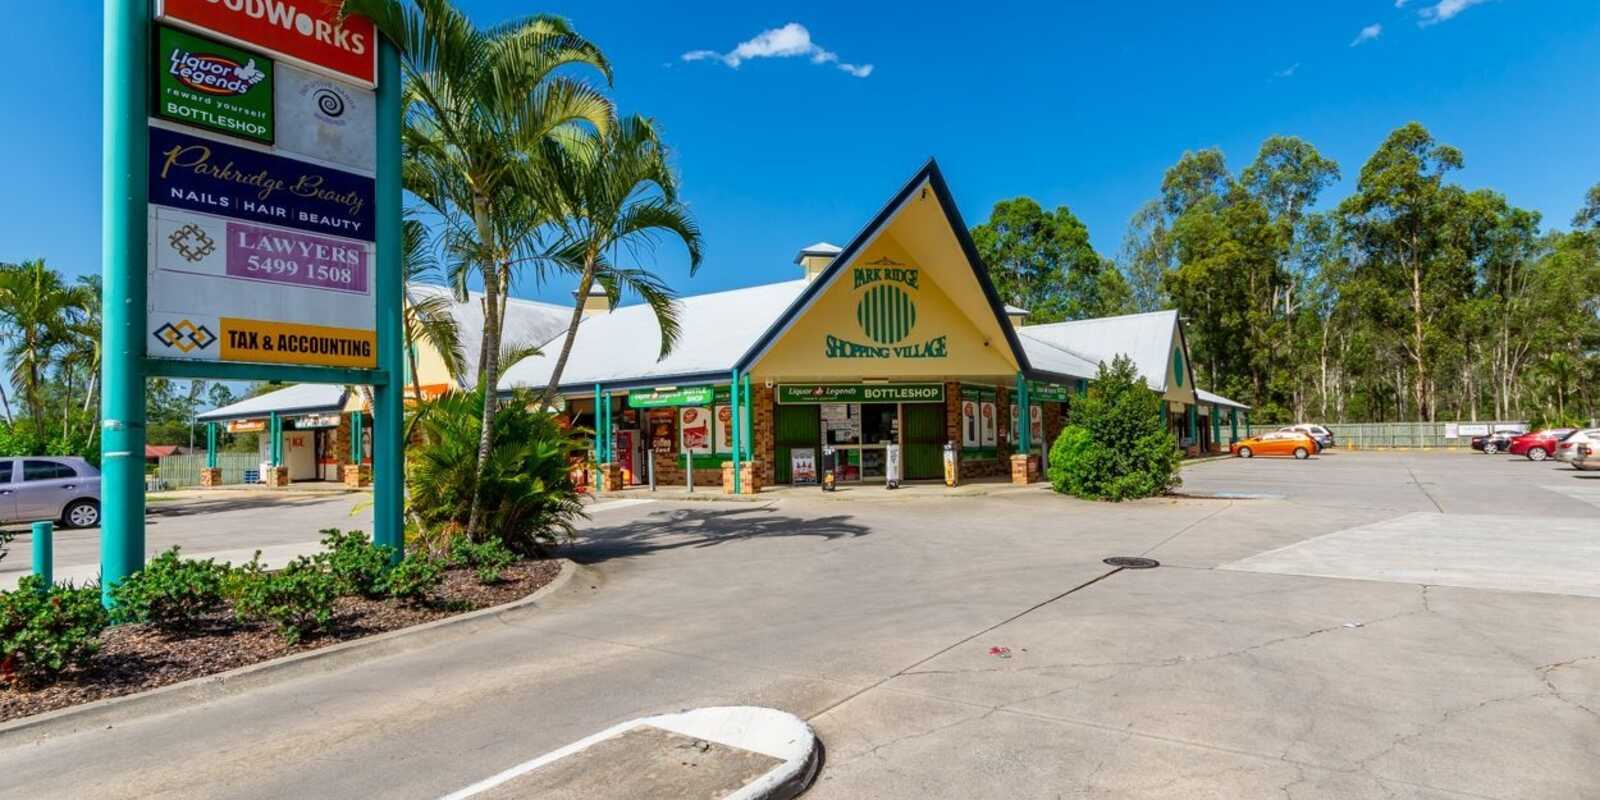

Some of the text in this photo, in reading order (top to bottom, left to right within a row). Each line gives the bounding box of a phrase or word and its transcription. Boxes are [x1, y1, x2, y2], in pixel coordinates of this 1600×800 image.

[169, 60, 248, 94] Legends
[170, 48, 232, 76] Liquor
[167, 87, 267, 119] reward yourself
[167, 102, 267, 136] BOTTLESHOP
[160, 145, 366, 216] Parkridge Beauty
[170, 187, 362, 232] NAILS HAIR BEAUTY
[238, 231, 360, 265] LAWYERS
[247, 255, 352, 284] 5499 1508
[853, 268, 919, 290] PARK RIDGE
[228, 330, 371, 357] TAX & ACCOUNTING
[825, 334, 948, 359] SHOPPING VILLAGE
[864, 388, 939, 398] BOTTLESHOP
